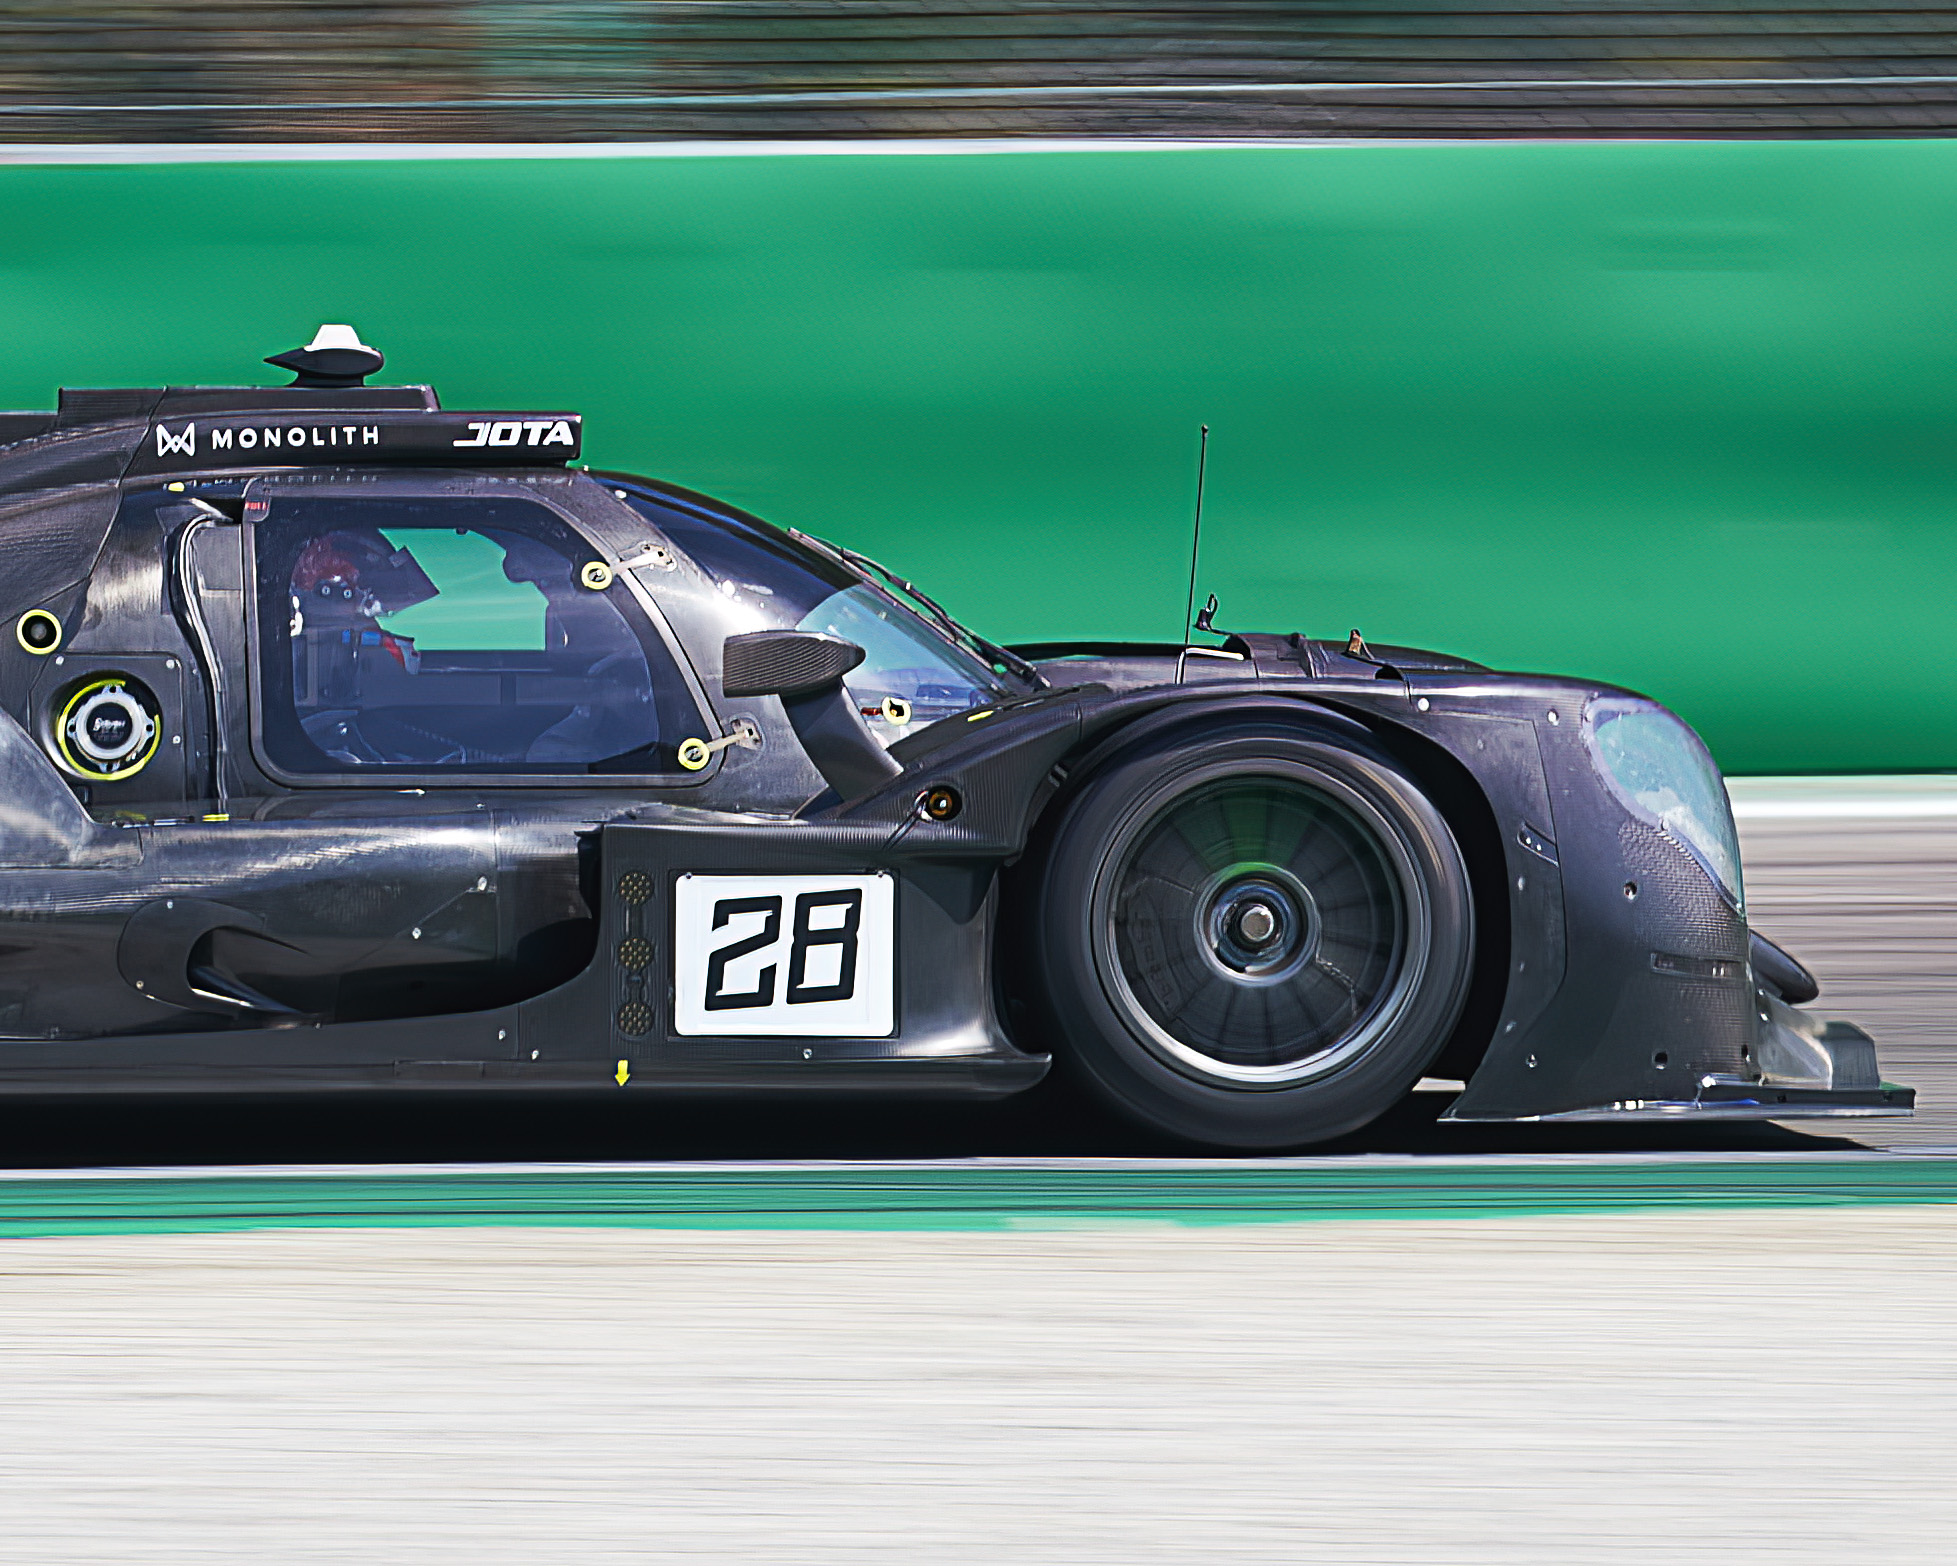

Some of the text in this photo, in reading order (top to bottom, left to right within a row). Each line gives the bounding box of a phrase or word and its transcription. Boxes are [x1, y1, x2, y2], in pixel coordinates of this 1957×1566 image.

[212, 426, 379, 450] MONOLITH
[453, 421, 574, 447] JOTA
[704, 887, 863, 1012] 28
